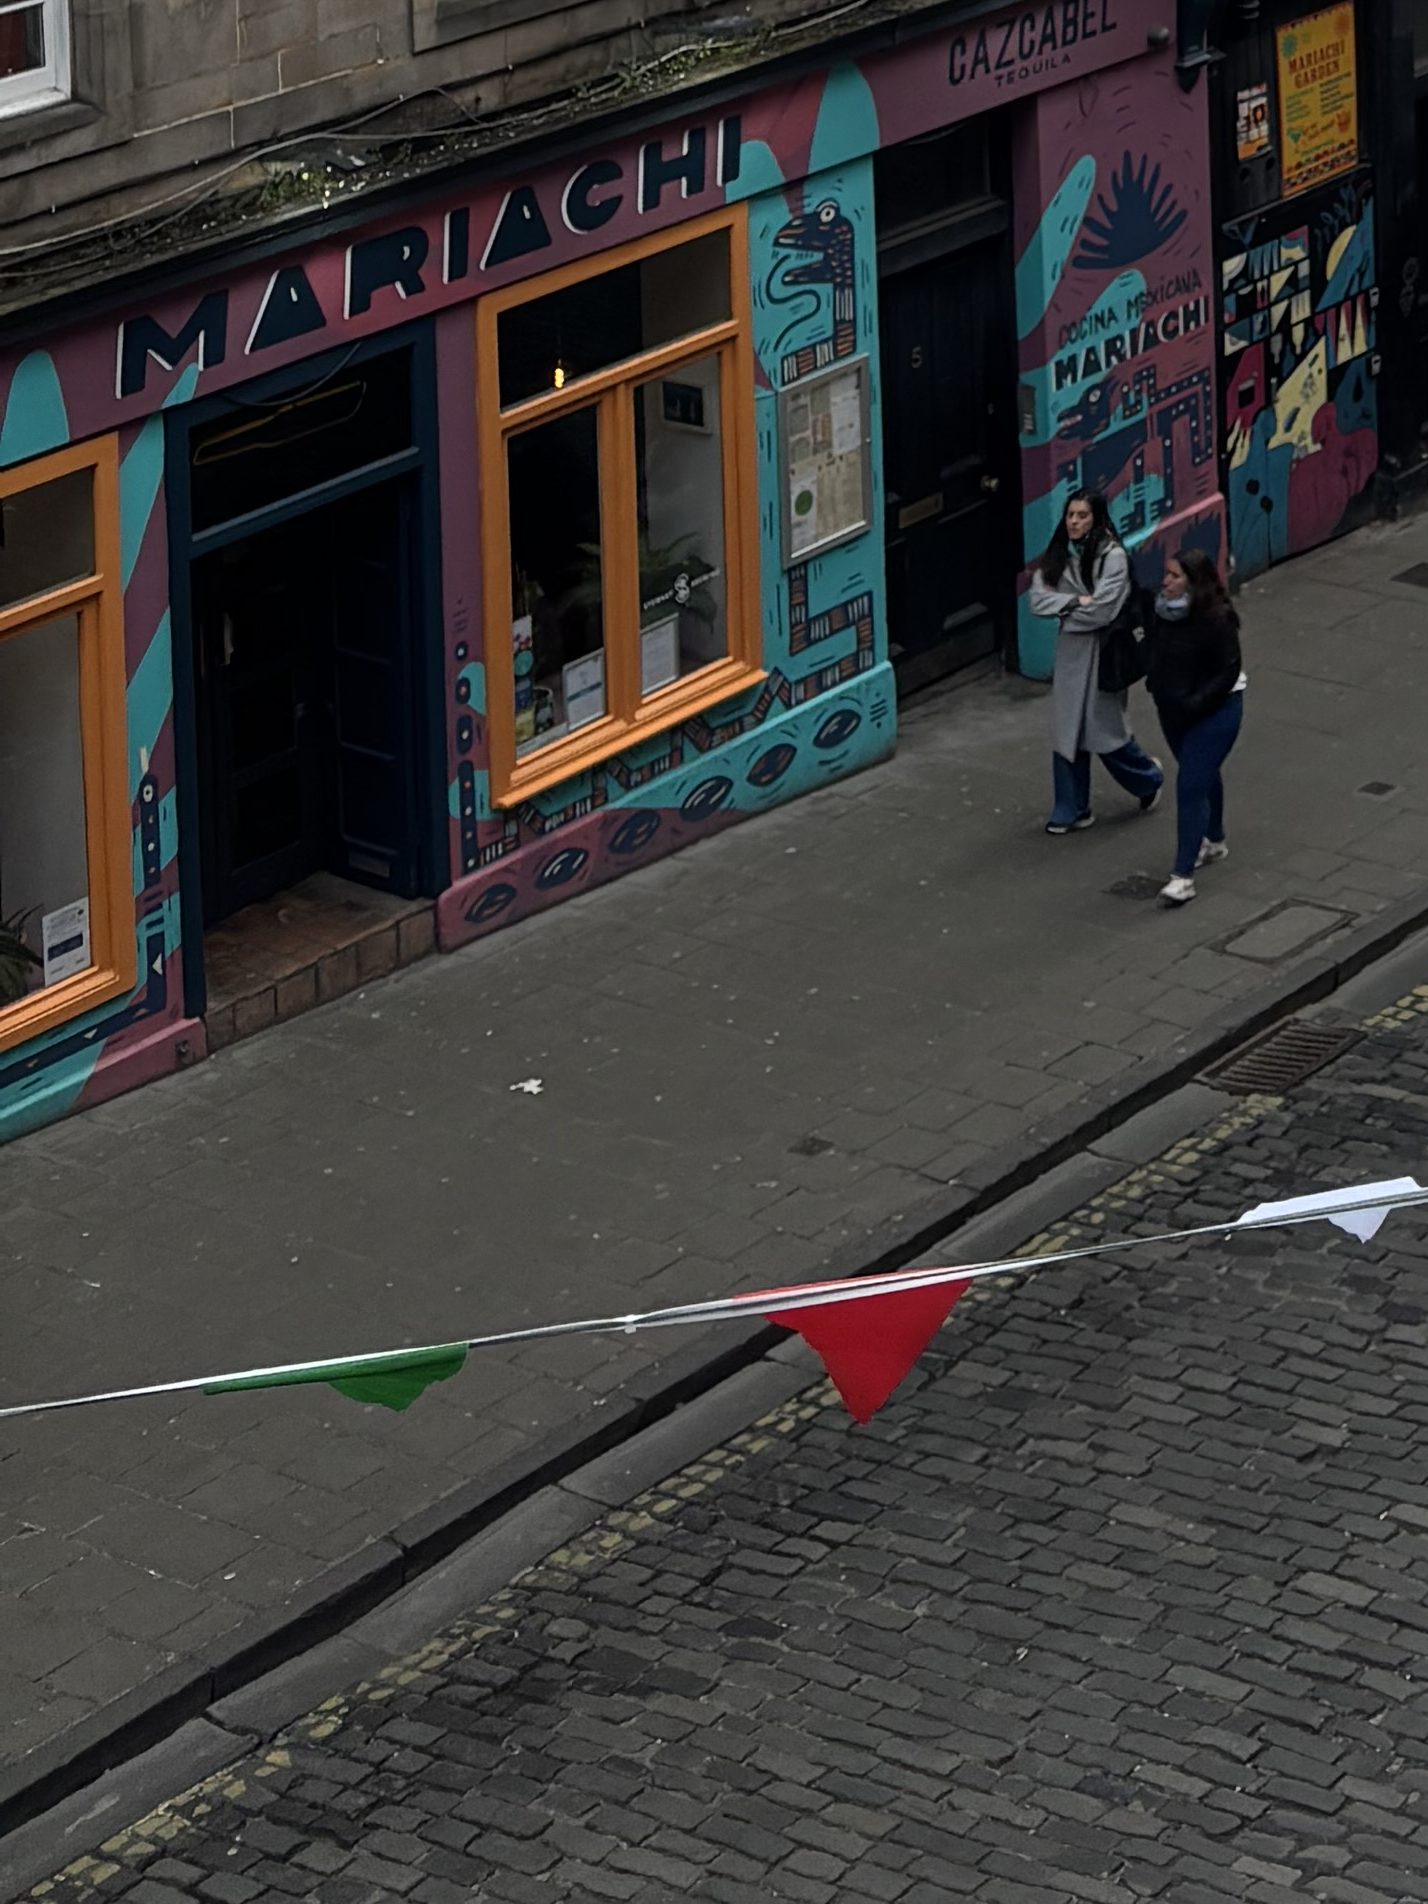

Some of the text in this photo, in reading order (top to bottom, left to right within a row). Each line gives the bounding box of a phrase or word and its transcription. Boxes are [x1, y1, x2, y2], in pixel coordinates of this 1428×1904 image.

[995, 53, 1072, 87] TEQUILA
[114, 115, 742, 400] MARIACHI
[1052, 295, 1209, 392] MARIACHI
